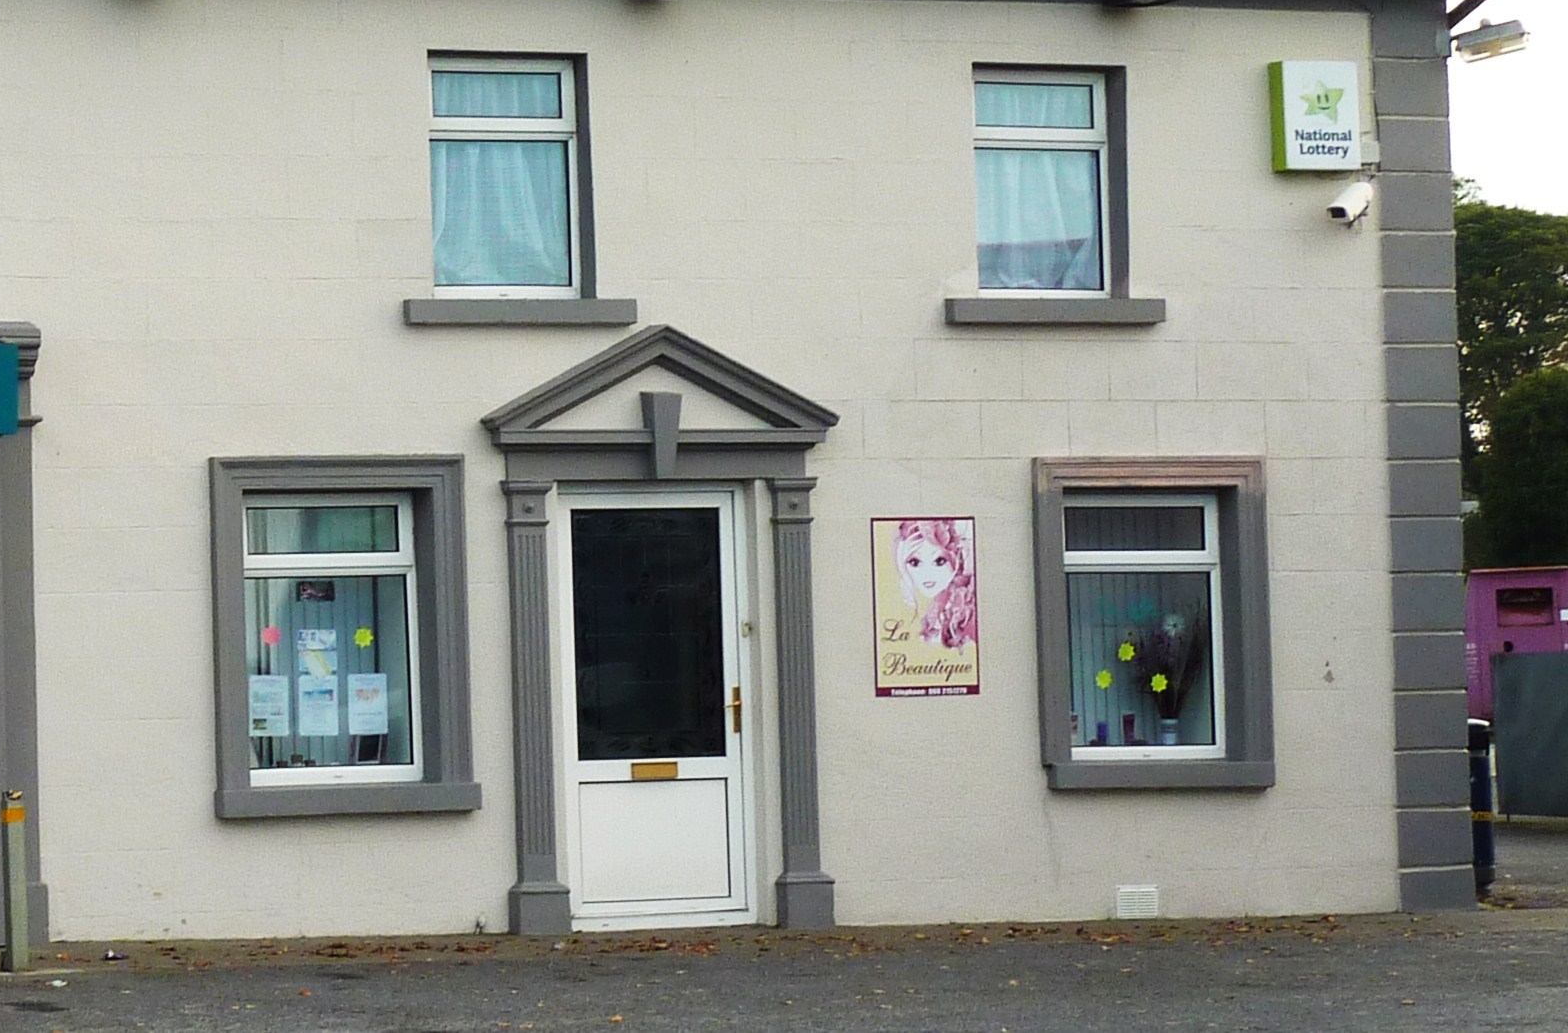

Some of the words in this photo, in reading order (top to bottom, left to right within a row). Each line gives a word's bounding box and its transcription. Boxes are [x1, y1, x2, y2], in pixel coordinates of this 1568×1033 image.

[1294, 129, 1352, 142] National
[1299, 144, 1349, 159] Lottery
[882, 618, 911, 642] La
[882, 652, 973, 682] Beautique
